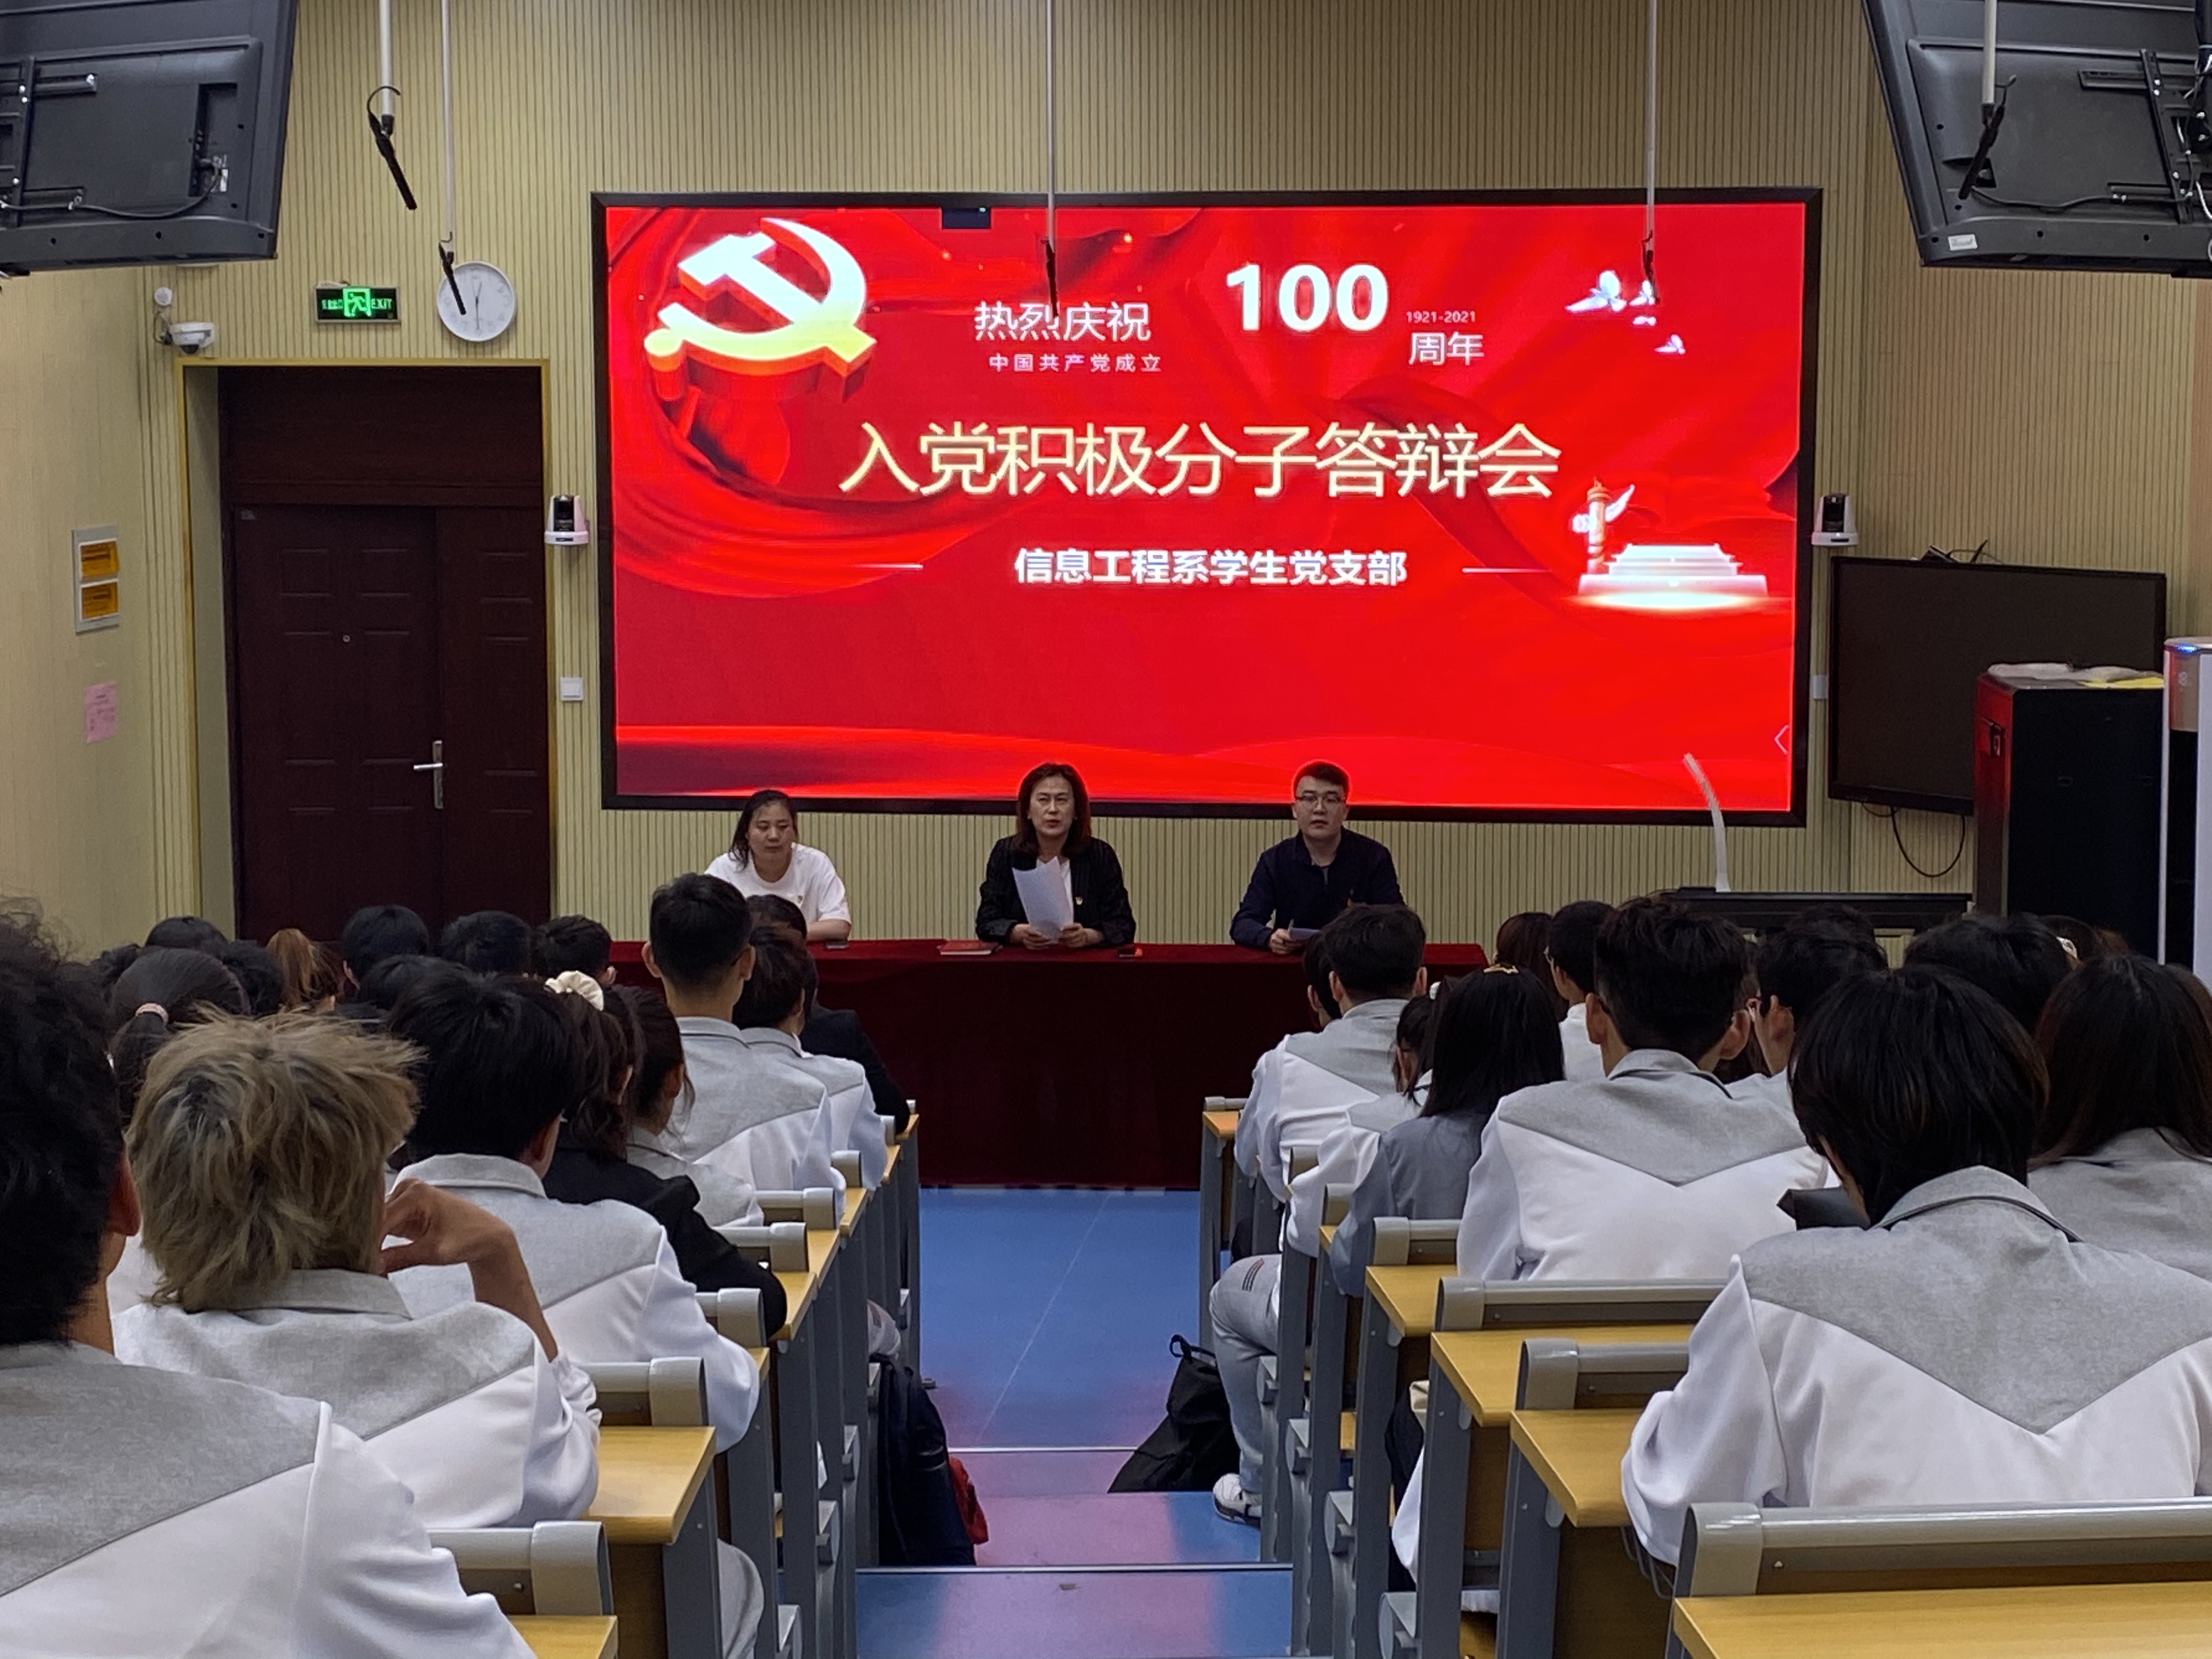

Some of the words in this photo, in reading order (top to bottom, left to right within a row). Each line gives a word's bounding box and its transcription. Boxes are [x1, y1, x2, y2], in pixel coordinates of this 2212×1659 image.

[371, 298, 392, 310] EXIT
[1227, 263, 1388, 332] 100
[974, 301, 1151, 341] 热烈庆祝
[1407, 311, 1475, 323] 1921-2021
[989, 353, 1161, 372] 中国共产党成立
[1409, 331, 1484, 365] 周年
[839, 421, 1561, 498] 入党积极分子答辩会
[1014, 548, 1407, 586] 信息工程系学生党支部
